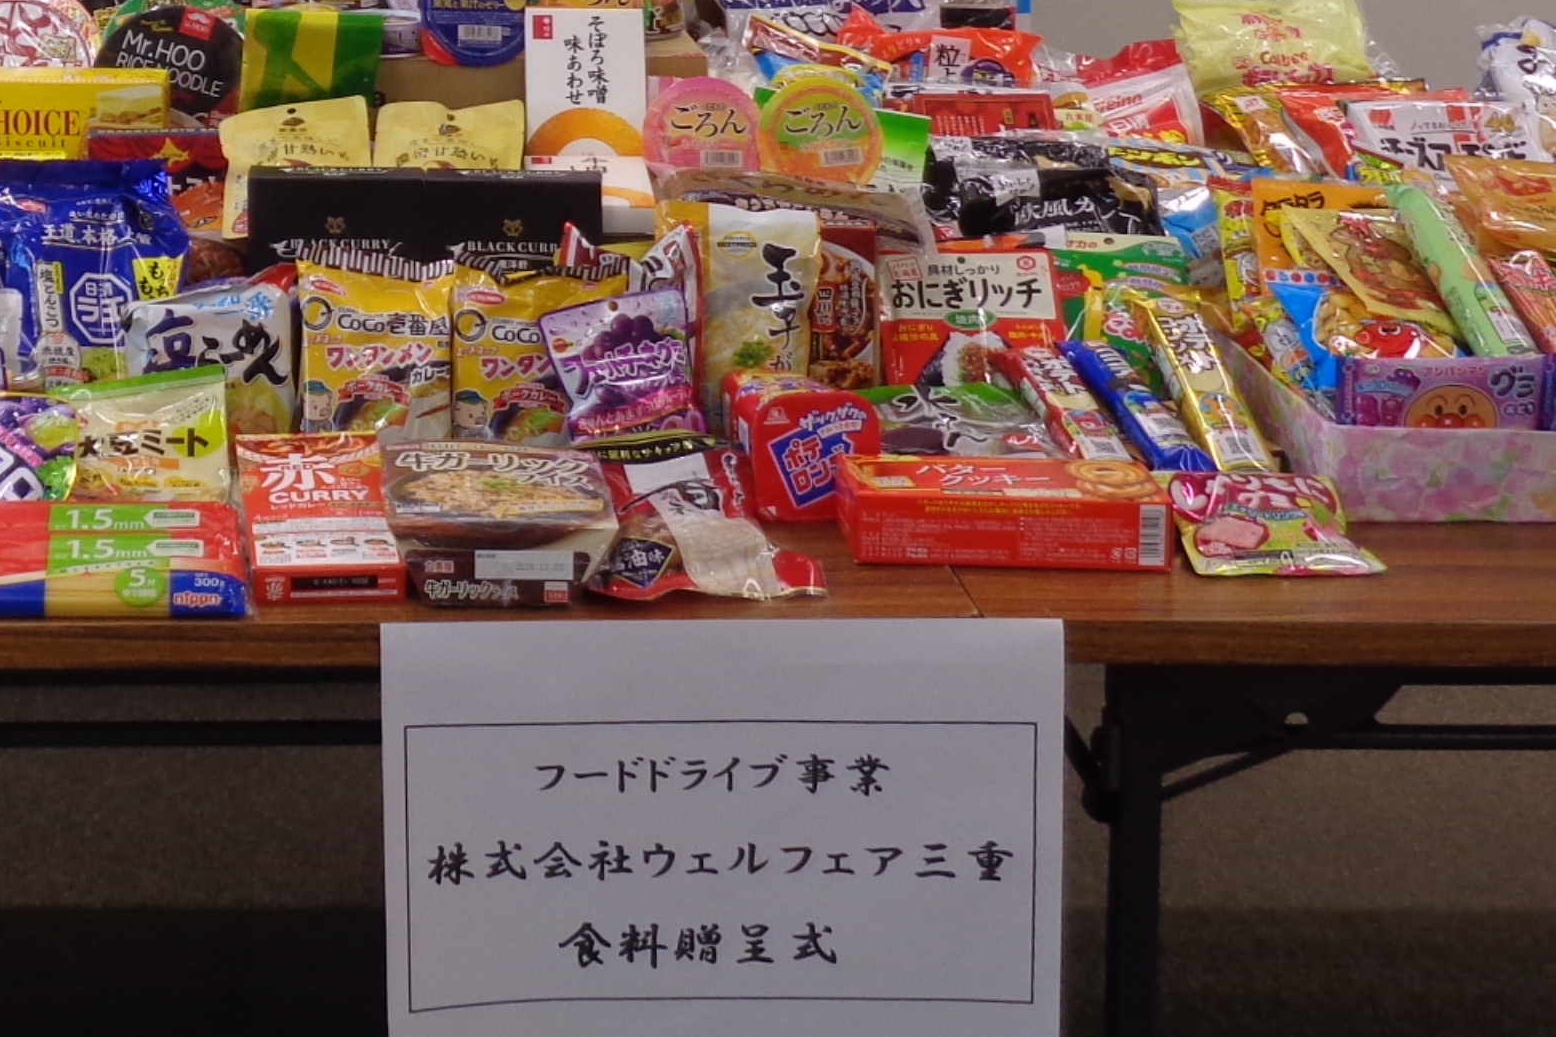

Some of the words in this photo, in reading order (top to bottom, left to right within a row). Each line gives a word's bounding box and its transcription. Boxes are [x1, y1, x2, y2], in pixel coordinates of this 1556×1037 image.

[121, 29, 206, 72] Mr.HOO
[586, 16, 610, 104] そぼろ味噌
[166, 67, 224, 98] OODLE
[563, 34, 583, 105] 味あわせ
[670, 104, 748, 136] ごろん
[785, 105, 864, 138] ごろん
[342, 238, 391, 251] CURRY
[468, 241, 516, 254] BLACK
[519, 241, 558, 254] CURR
[927, 264, 1001, 277] 具材しっかり
[890, 276, 1042, 310] おにぎリッチ
[326, 342, 433, 371] ワンタンメン
[1422, 366, 1489, 378] アンパンマン
[346, 381, 402, 396] ポークカレー
[1490, 369, 1537, 398] グミ
[261, 452, 336, 491] 赤
[268, 489, 369, 504] CURRY
[535, 754, 891, 797] フードドライブ事業
[426, 840, 1016, 887] 株式会社ウェルフェア三重
[557, 922, 839, 969] 食料贈呈式
